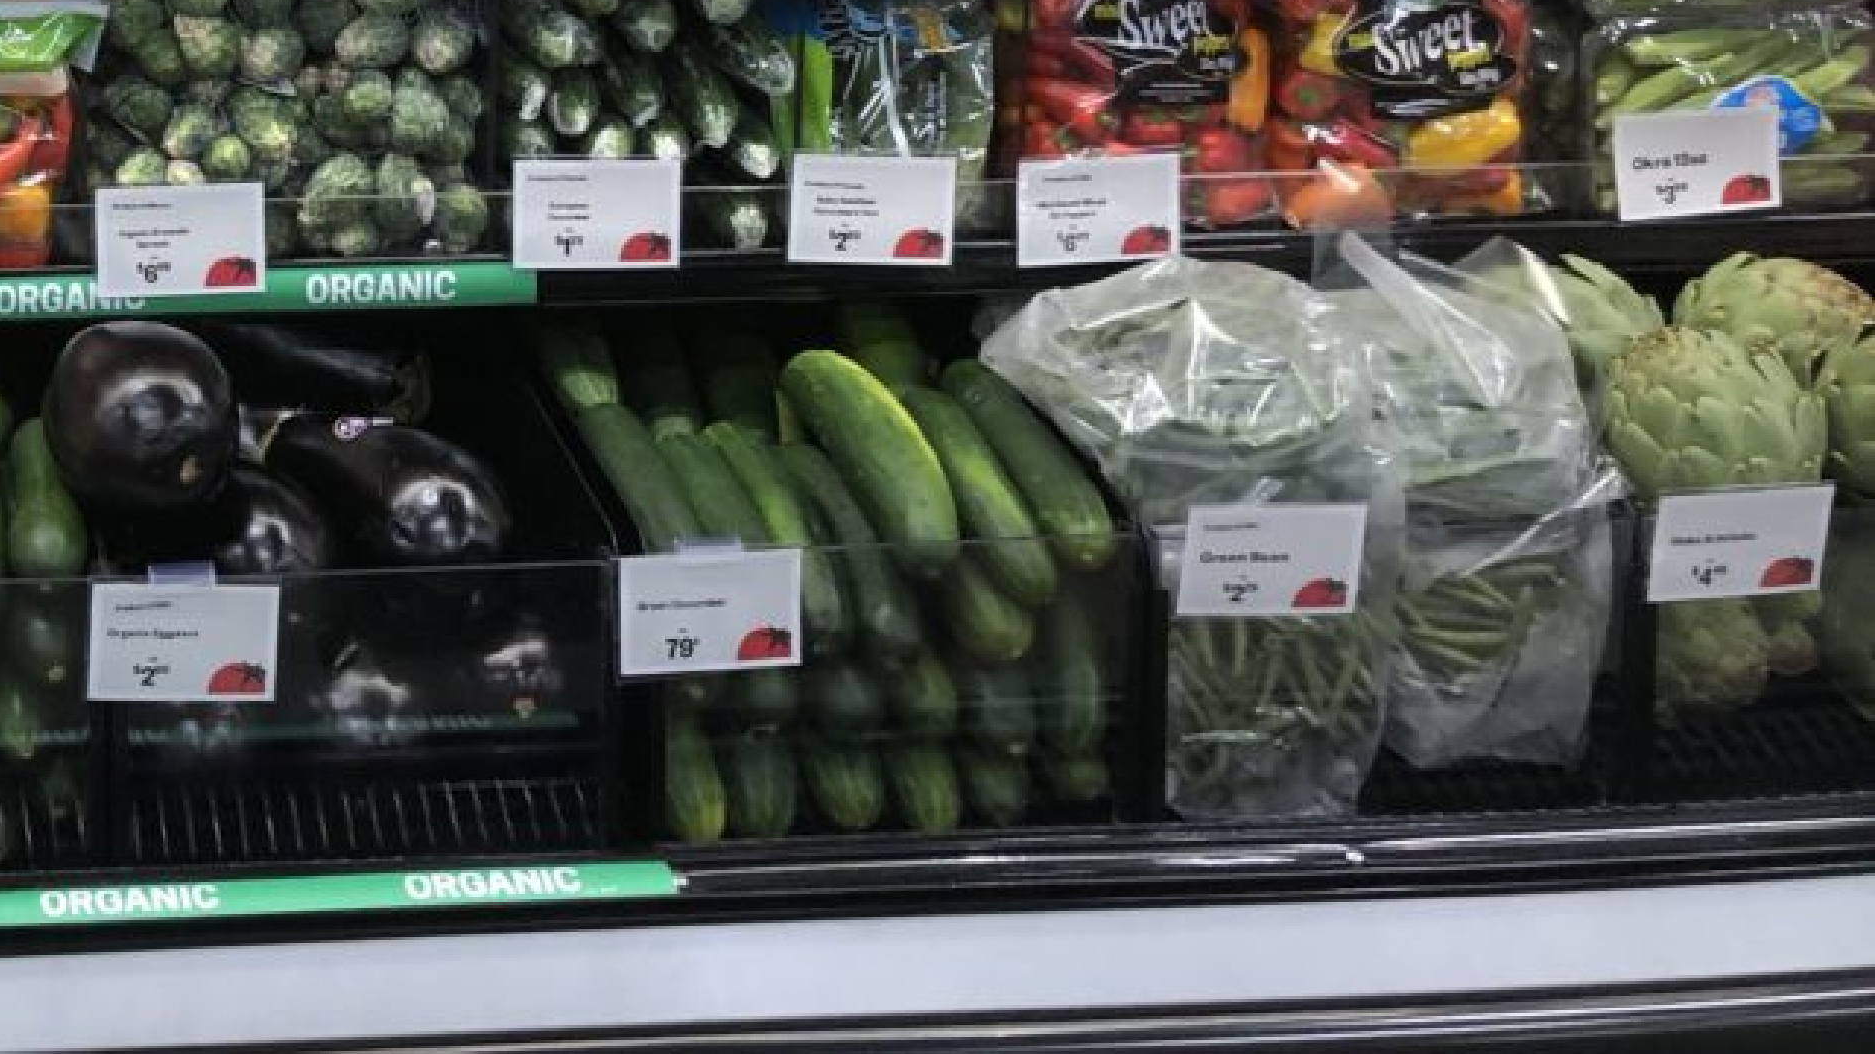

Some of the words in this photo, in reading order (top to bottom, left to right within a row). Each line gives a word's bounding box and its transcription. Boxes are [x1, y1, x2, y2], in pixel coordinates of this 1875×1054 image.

[1371, 9, 1487, 75] Sweet
[306, 271, 456, 304] ORGANIC
[404, 868, 582, 901] ORGANIC
[40, 885, 220, 918] ORGANIC
